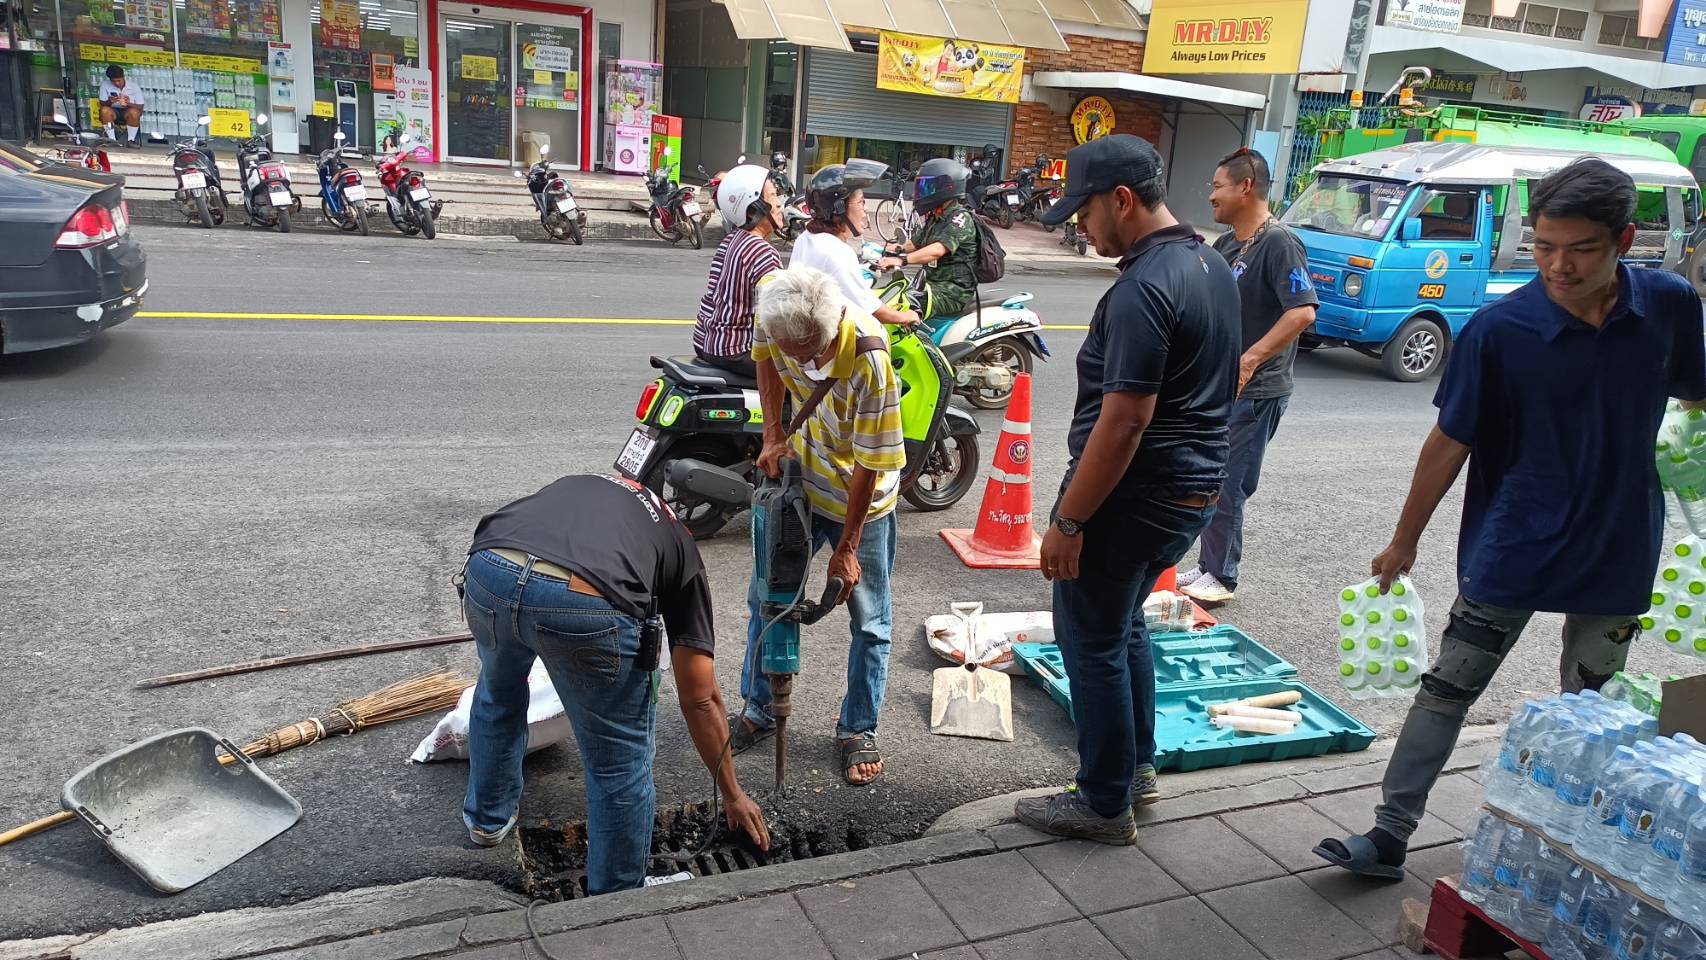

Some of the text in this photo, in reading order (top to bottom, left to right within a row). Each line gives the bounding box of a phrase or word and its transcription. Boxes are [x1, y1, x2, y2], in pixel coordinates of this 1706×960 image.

[1171, 50, 1266, 63] Always Low Prices
[231, 122, 244, 132] 42
[1418, 284, 1444, 299] 450
[620, 455, 640, 473] 2805
[1564, 773, 1581, 785] eto
[1664, 826, 1684, 840] eto
[1560, 890, 1575, 904] eto
